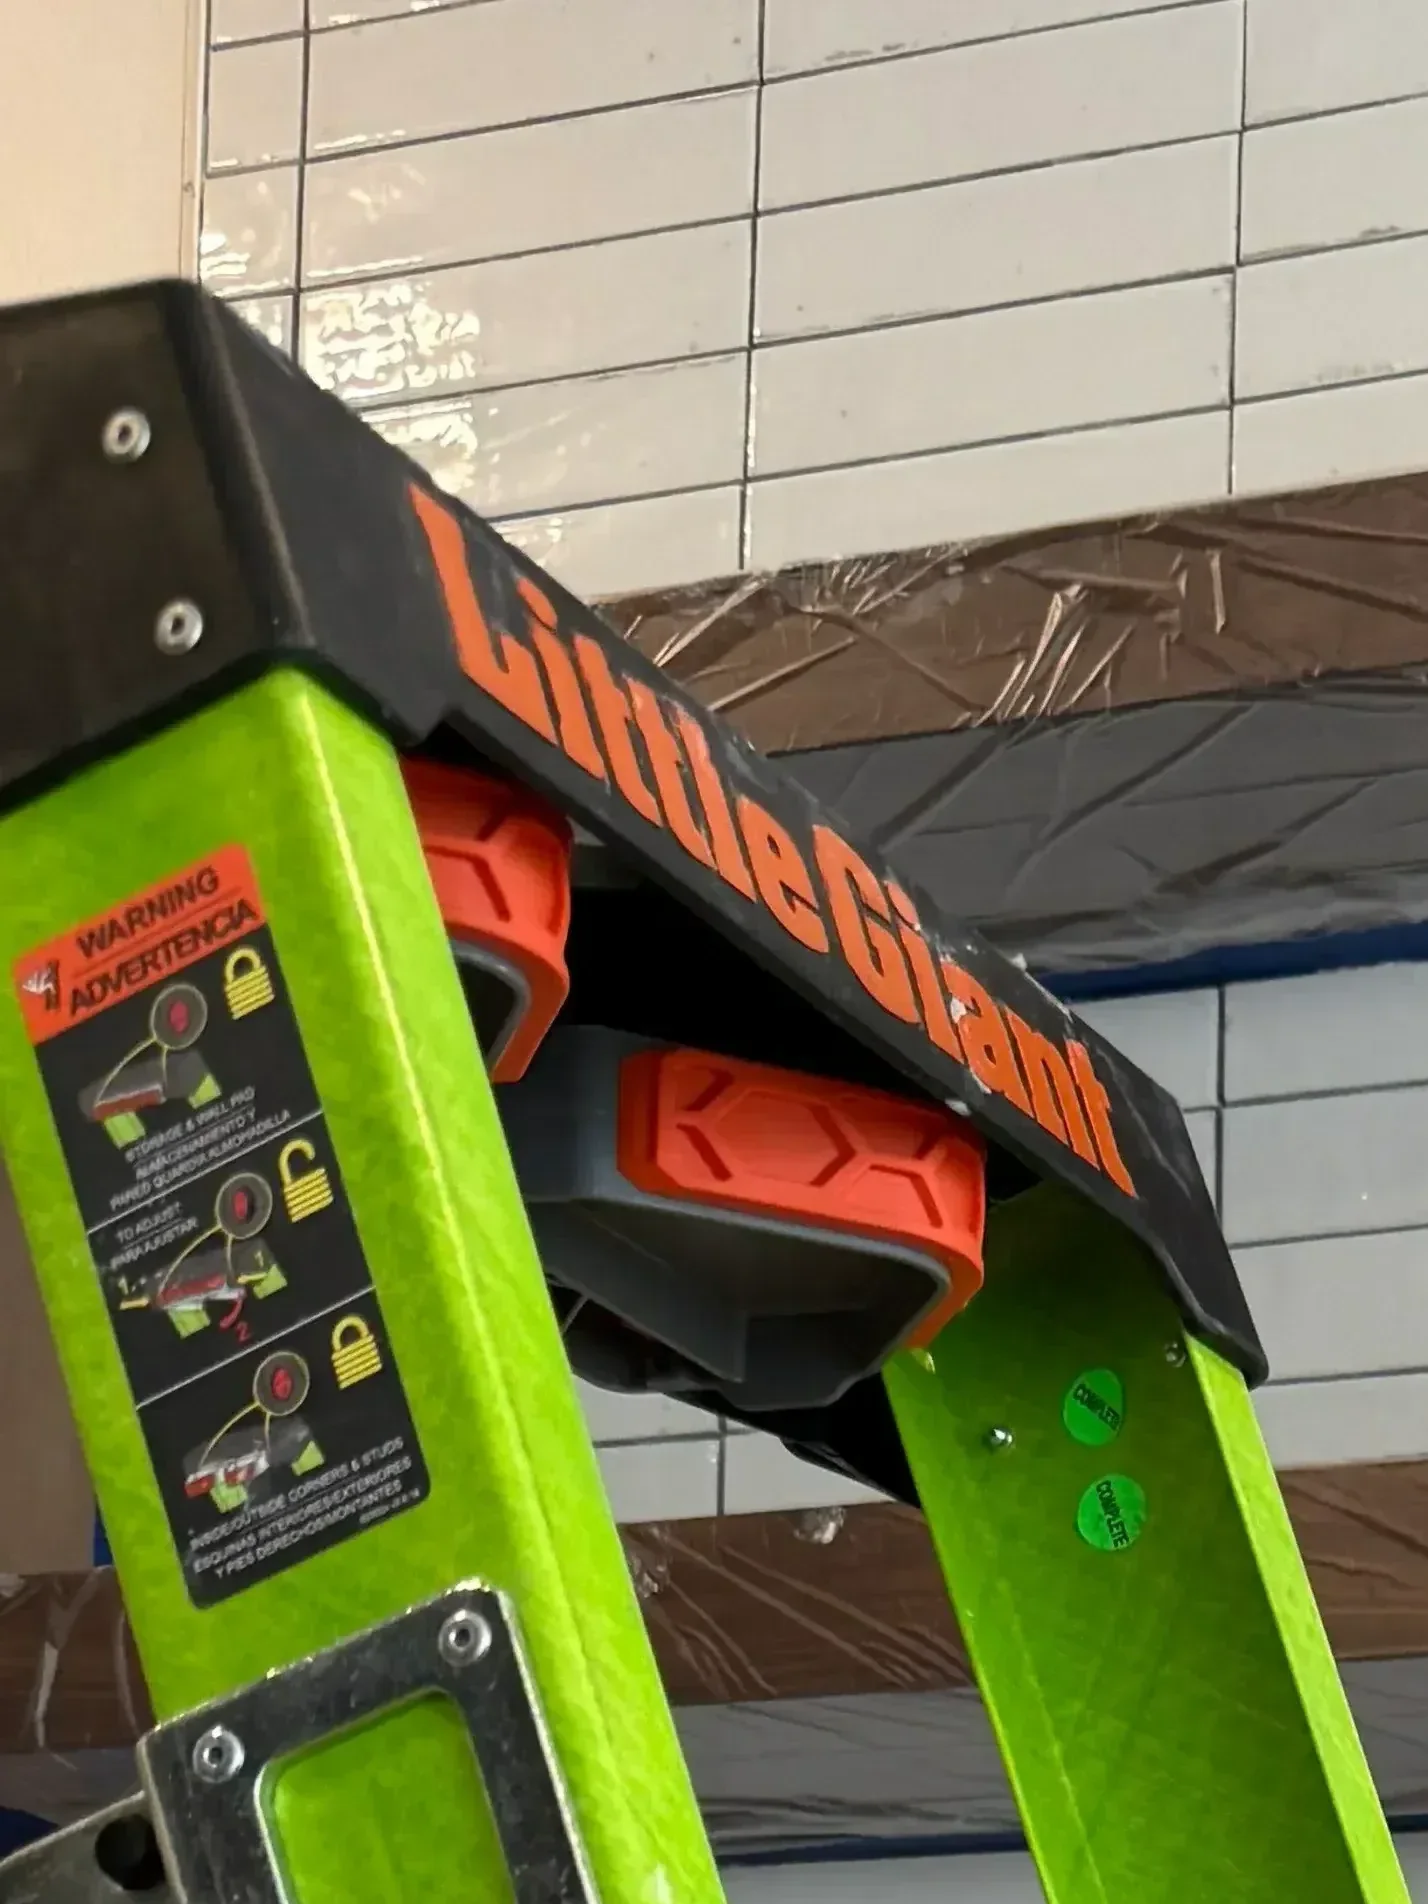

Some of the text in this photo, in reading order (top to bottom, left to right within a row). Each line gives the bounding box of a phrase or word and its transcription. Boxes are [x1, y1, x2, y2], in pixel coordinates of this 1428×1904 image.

[77, 868, 218, 957] WARNING
[70, 900, 259, 1014] ADVERTENCIA
[115, 1226, 136, 1243] TO
[1096, 1480, 1129, 1548] COMPLETE
